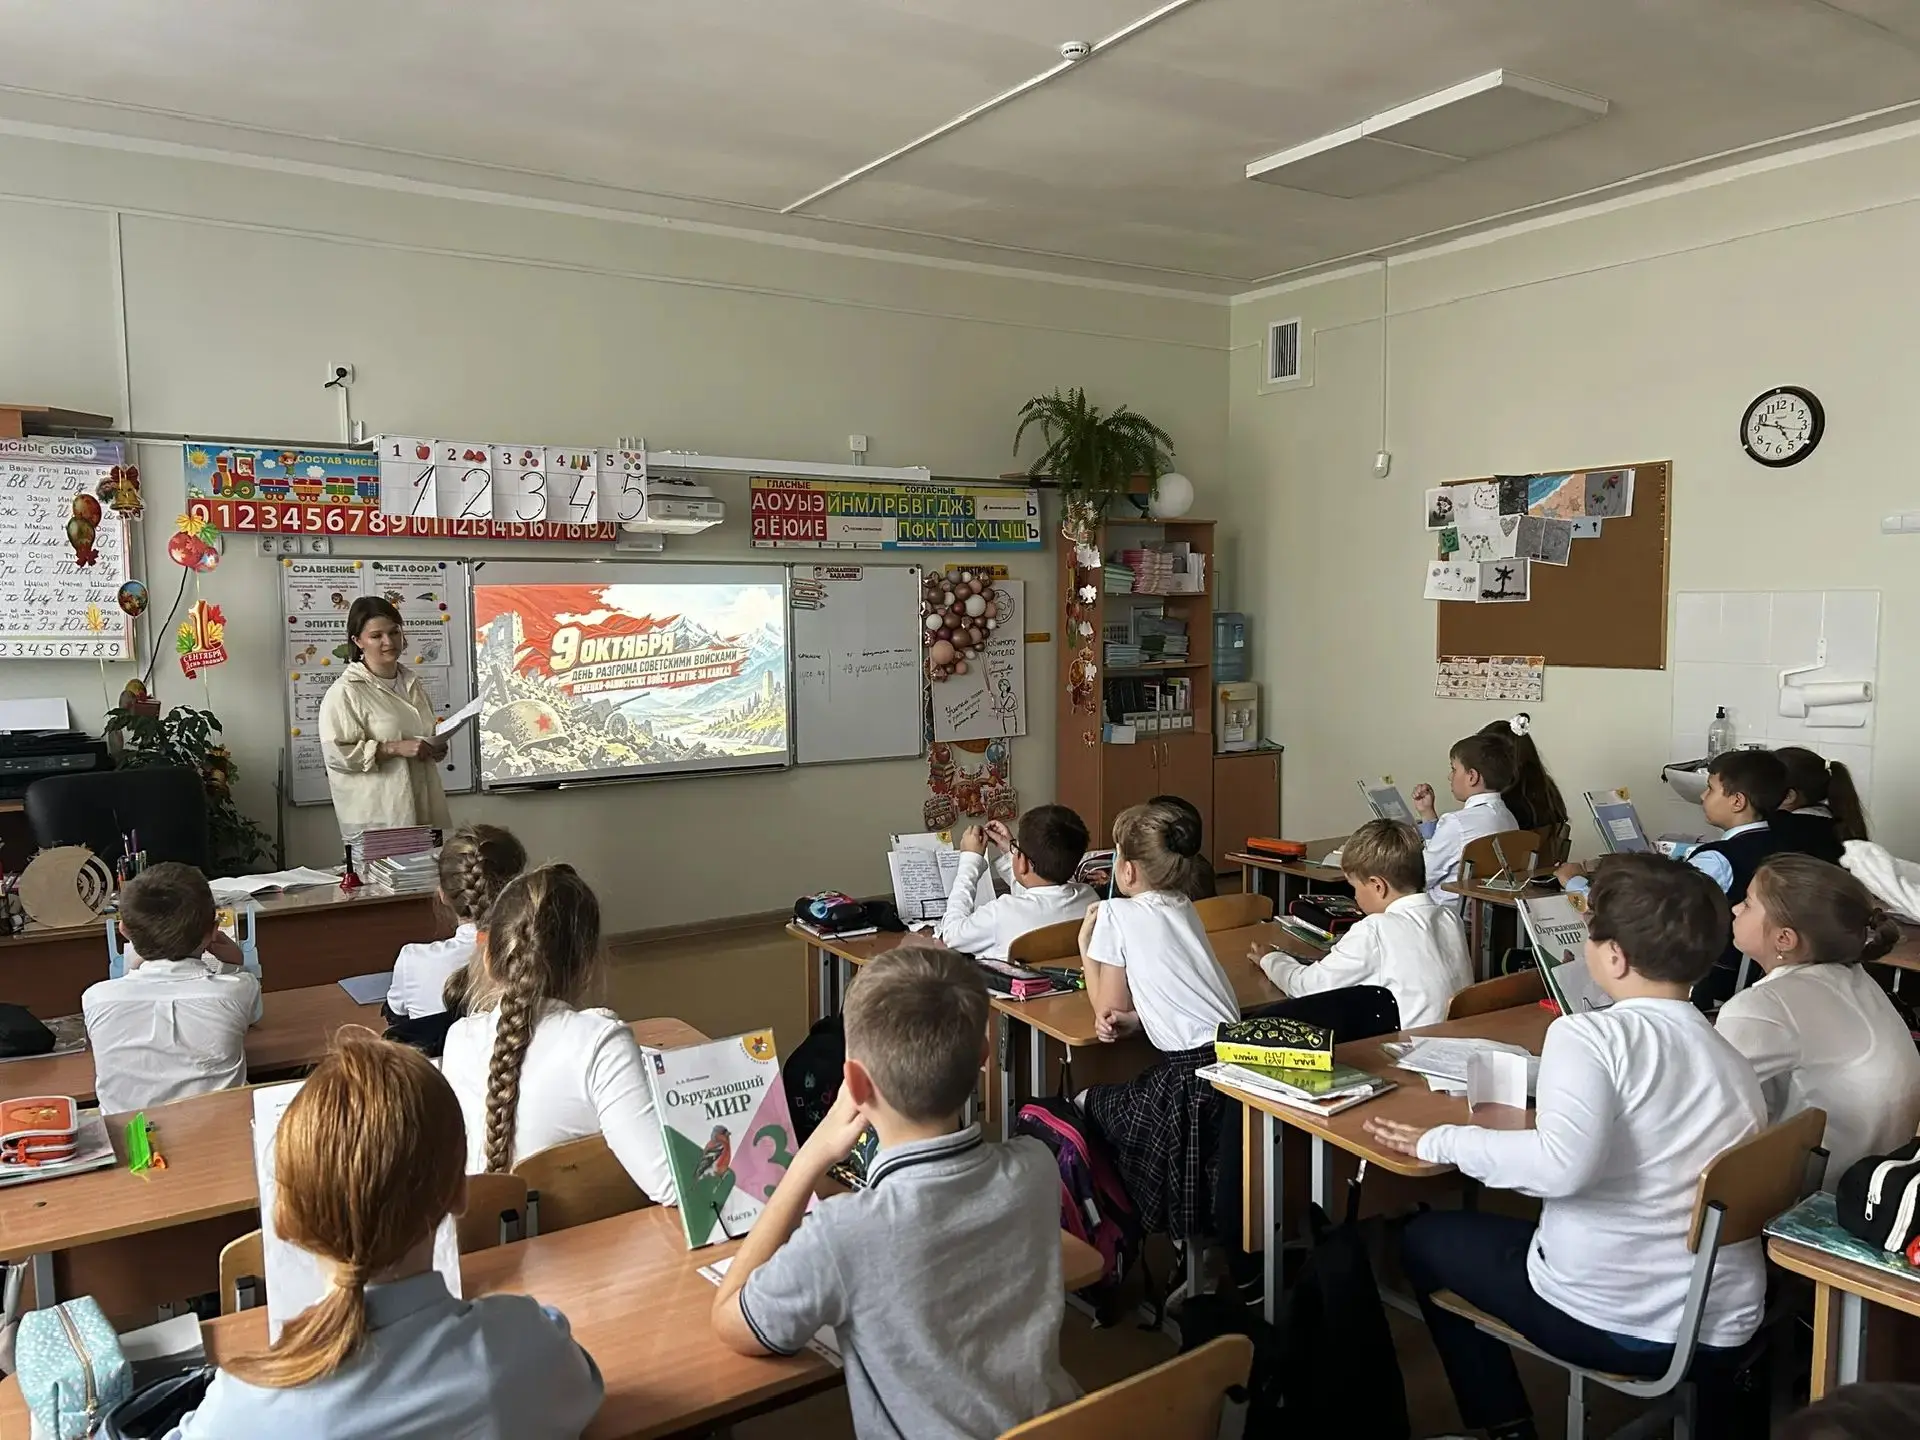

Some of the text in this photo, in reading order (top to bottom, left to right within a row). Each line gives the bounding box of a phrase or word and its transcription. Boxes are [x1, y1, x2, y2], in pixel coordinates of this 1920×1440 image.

[1766, 404, 1775, 414] 11
[1776, 400, 1787, 410] 12
[1791, 402, 1795, 412] 1
[1758, 413, 1767, 423] 10
[1797, 409, 1805, 420] 2
[1753, 425, 1760, 434] 9
[1801, 419, 1808, 430] 3
[1757, 435, 1763, 445] 8
[1795, 431, 1803, 441] 4
[51, 445, 93, 455] БУКВЫ
[393, 443, 402, 457] 1
[1765, 442, 1771, 452] 7
[1775, 444, 1782, 454] 6
[1787, 440, 1794, 450] 5
[298, 455, 342, 465] СОСТАВ
[447, 448, 457, 461] 2
[503, 452, 512, 465] 3
[556, 454, 566, 466] 4
[606, 454, 614, 467] 5
[412, 465, 435, 516] 1
[766, 480, 812, 490] ГЛАСНЫЕ
[904, 486, 956, 495] СОГЛАСНЫЕ
[460, 468, 491, 518] 2
[516, 471, 546, 521] 3
[569, 475, 596, 522] 4
[618, 473, 645, 521] 5
[1026, 501, 1037, 516] Ь
[191, 504, 617, 539] 0 1 2 3 4 5 6 7 8 9 10 11 12 13 14 15 16 17 18 19 20
[292, 565, 356, 574] СРАВНЕНИЕ
[379, 564, 438, 573] МЕТАФОРА
[188, 599, 210, 652] 1
[304, 620, 347, 628] ЭПИТЕТ
[403, 619, 444, 627] ТВОРЕНИЕ
[12, 643, 23, 656] 3
[28, 643, 40, 656] 4
[43, 643, 56, 656] 5
[59, 643, 71, 656] 6
[75, 643, 89, 656] 7
[93, 643, 105, 656] 8
[108, 642, 120, 657] 9
[550, 626, 675, 672] 9 ОКТЯБРЯ
[183, 649, 222, 663] СЕНТЯБРЯ
[571, 649, 738, 682] ДЕНЬ РАЗГРОМА СОВЕТСКИМИ ВОЙСКАМИ
[1555, 930, 1581, 946] МИР
[666, 1074, 765, 1107] Окружающий
[704, 1093, 752, 1121] МИР
[752, 1123, 796, 1198] 3
[727, 1210, 753, 1222] Часть
